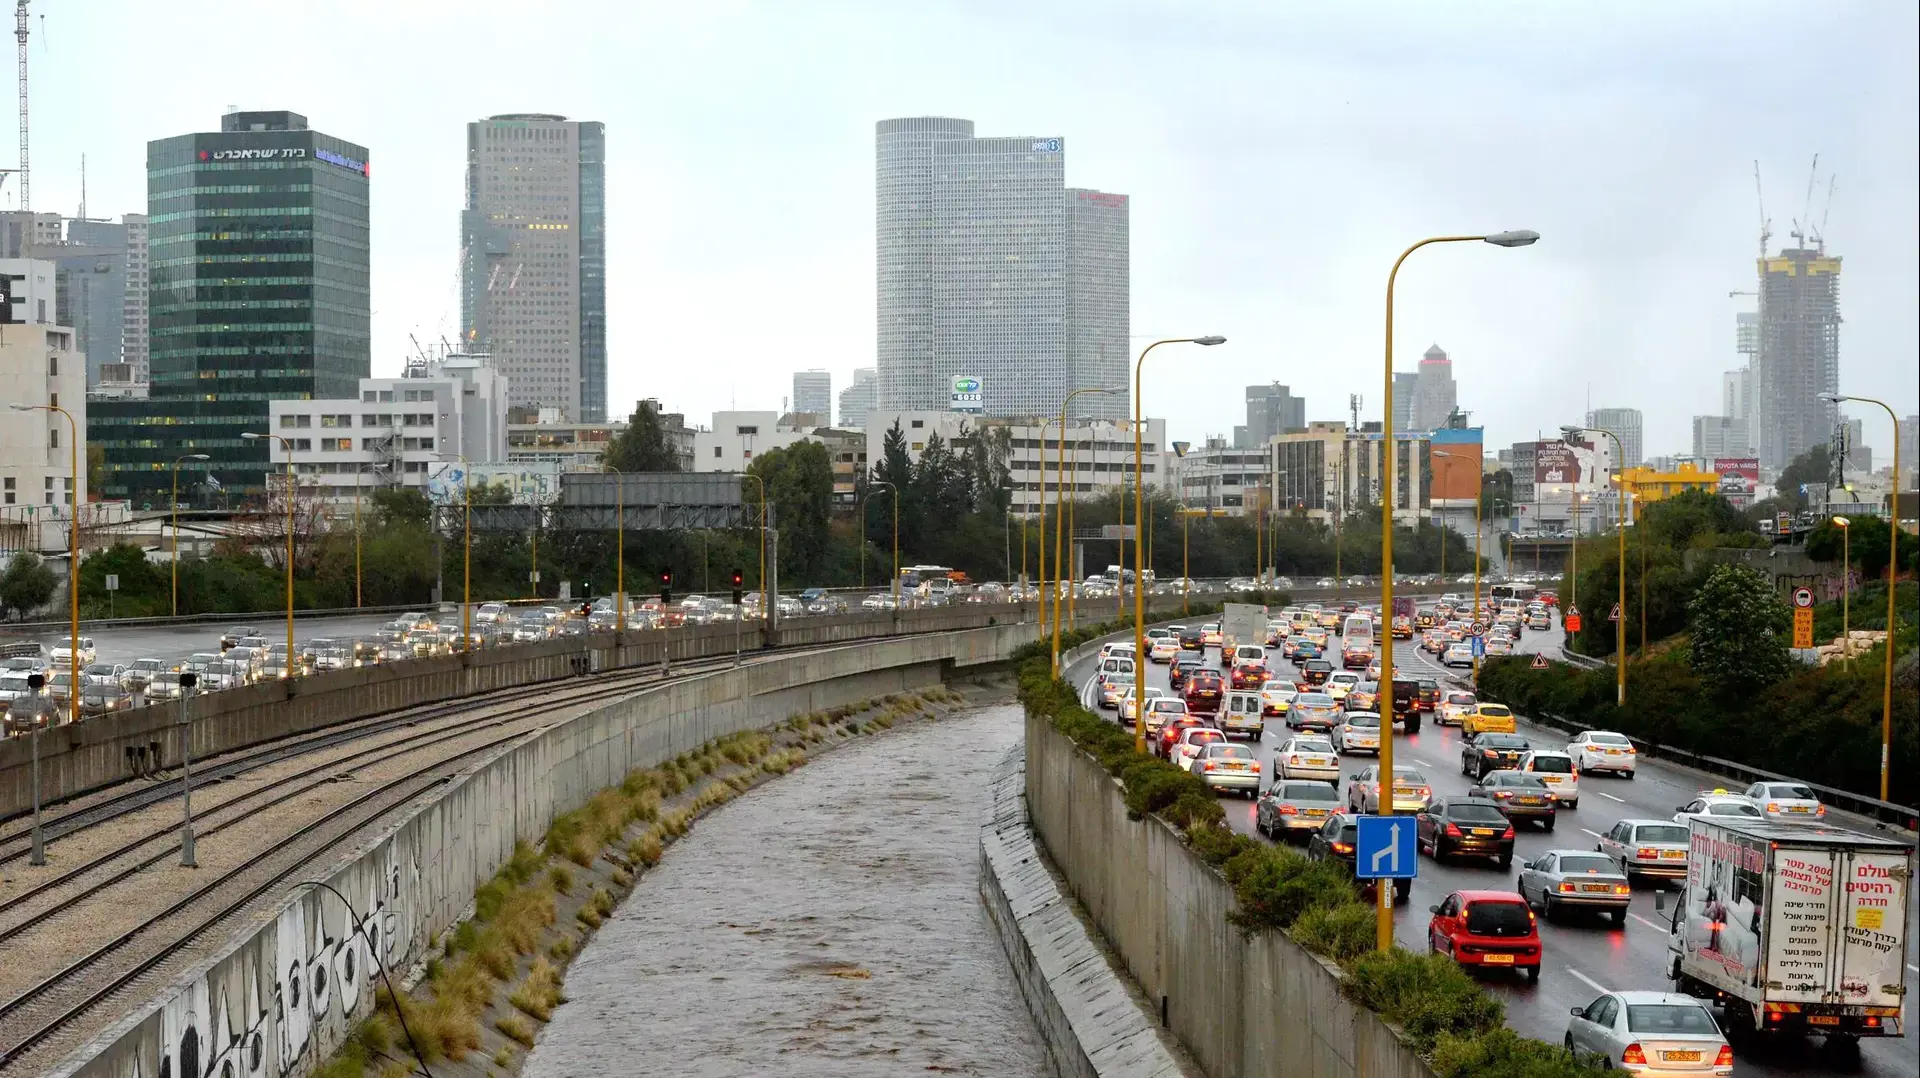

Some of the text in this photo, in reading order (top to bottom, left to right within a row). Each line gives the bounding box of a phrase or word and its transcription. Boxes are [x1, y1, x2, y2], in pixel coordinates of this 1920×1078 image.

[214, 147, 306, 160] בית ישראכרט
[1785, 858, 1833, 876] 2000 מטר
[1858, 864, 1890, 878] עולם
[1781, 868, 1831, 886] של תצוגה
[1784, 880, 1822, 895] מרהיבה
[1785, 901, 1804, 909] שינה
[1858, 897, 1888, 907] חדרה
[1784, 912, 1802, 920] אוכל
[1791, 924, 1816, 932] סלונים
[1849, 926, 1897, 944] בדרך לעוד
[1789, 937, 1817, 945] מזנונים
[1782, 948, 1822, 957] ספות נוער
[1780, 959, 1802, 968] ילדים
[1788, 972, 1814, 980] ארונות
